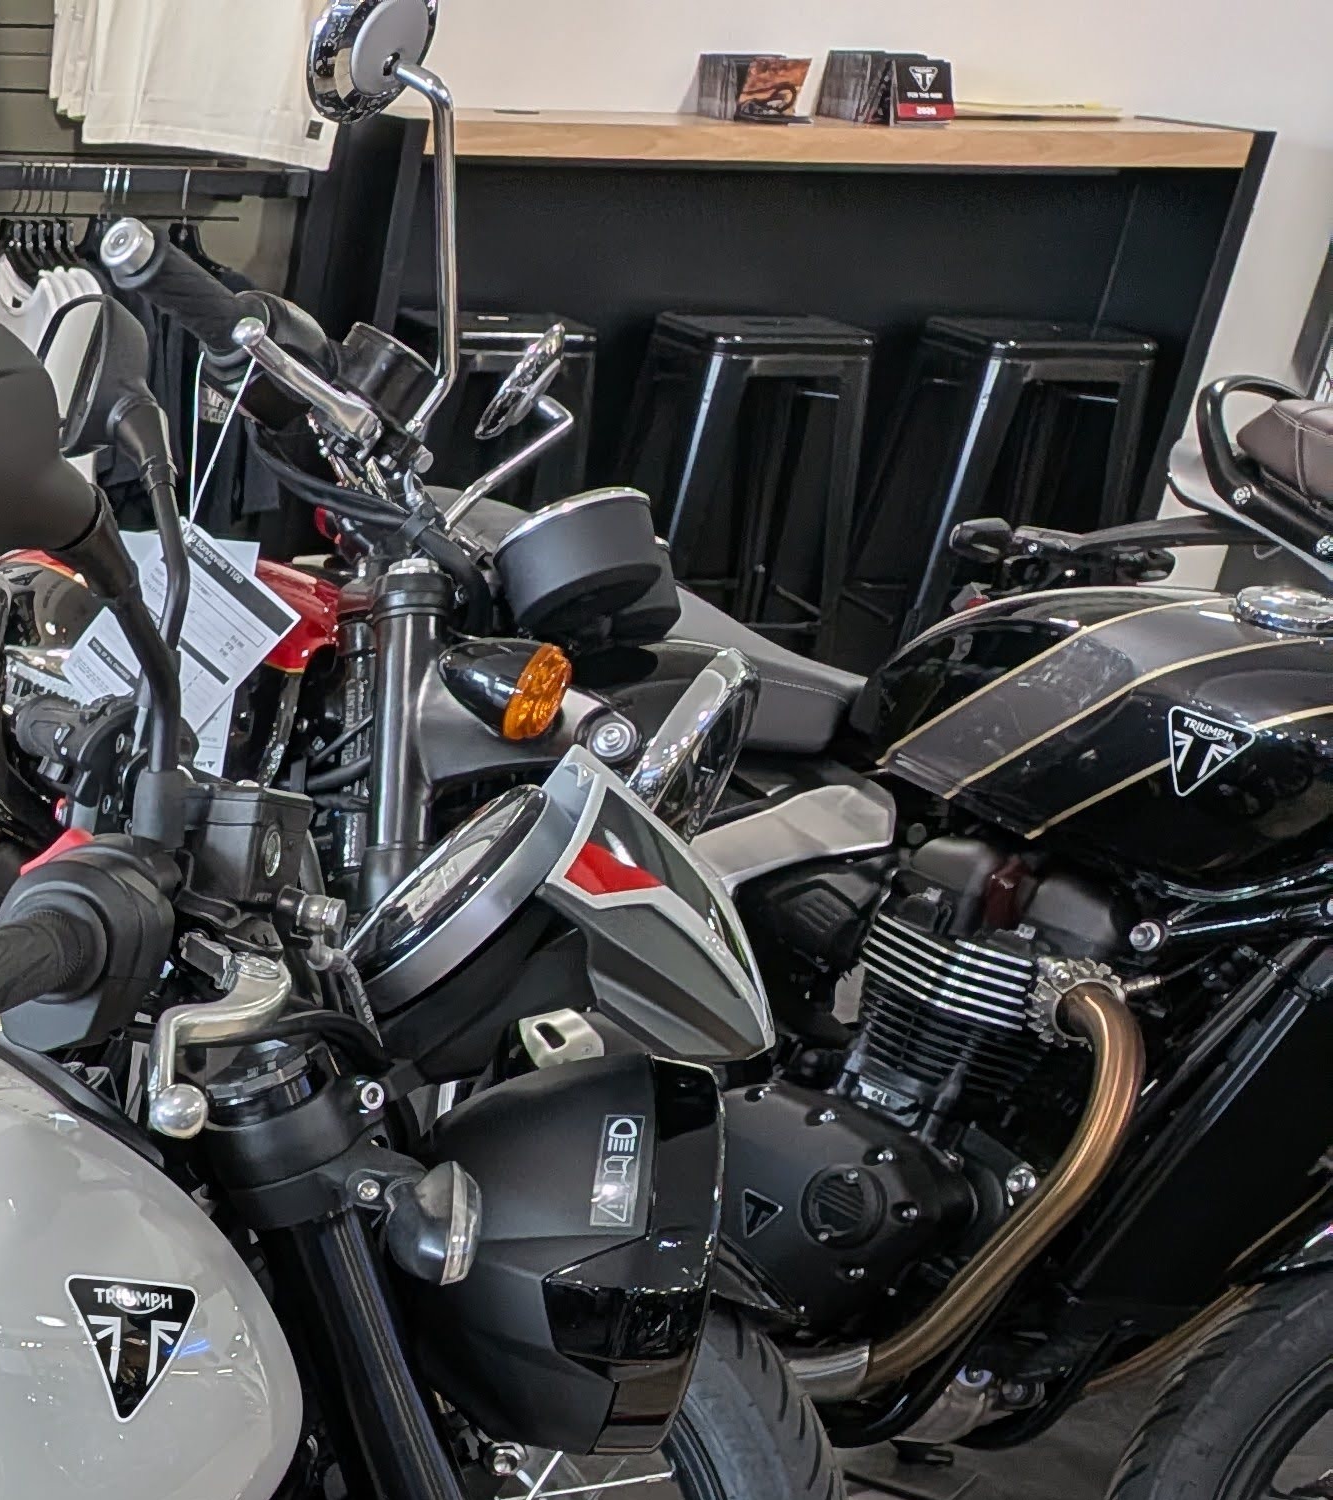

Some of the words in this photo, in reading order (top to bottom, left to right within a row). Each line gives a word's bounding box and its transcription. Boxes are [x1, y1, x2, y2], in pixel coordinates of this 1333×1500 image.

[195, 538, 228, 570] Bonneville
[225, 566, 244, 584] T100
[1183, 716, 1234, 742] TRIUMPH
